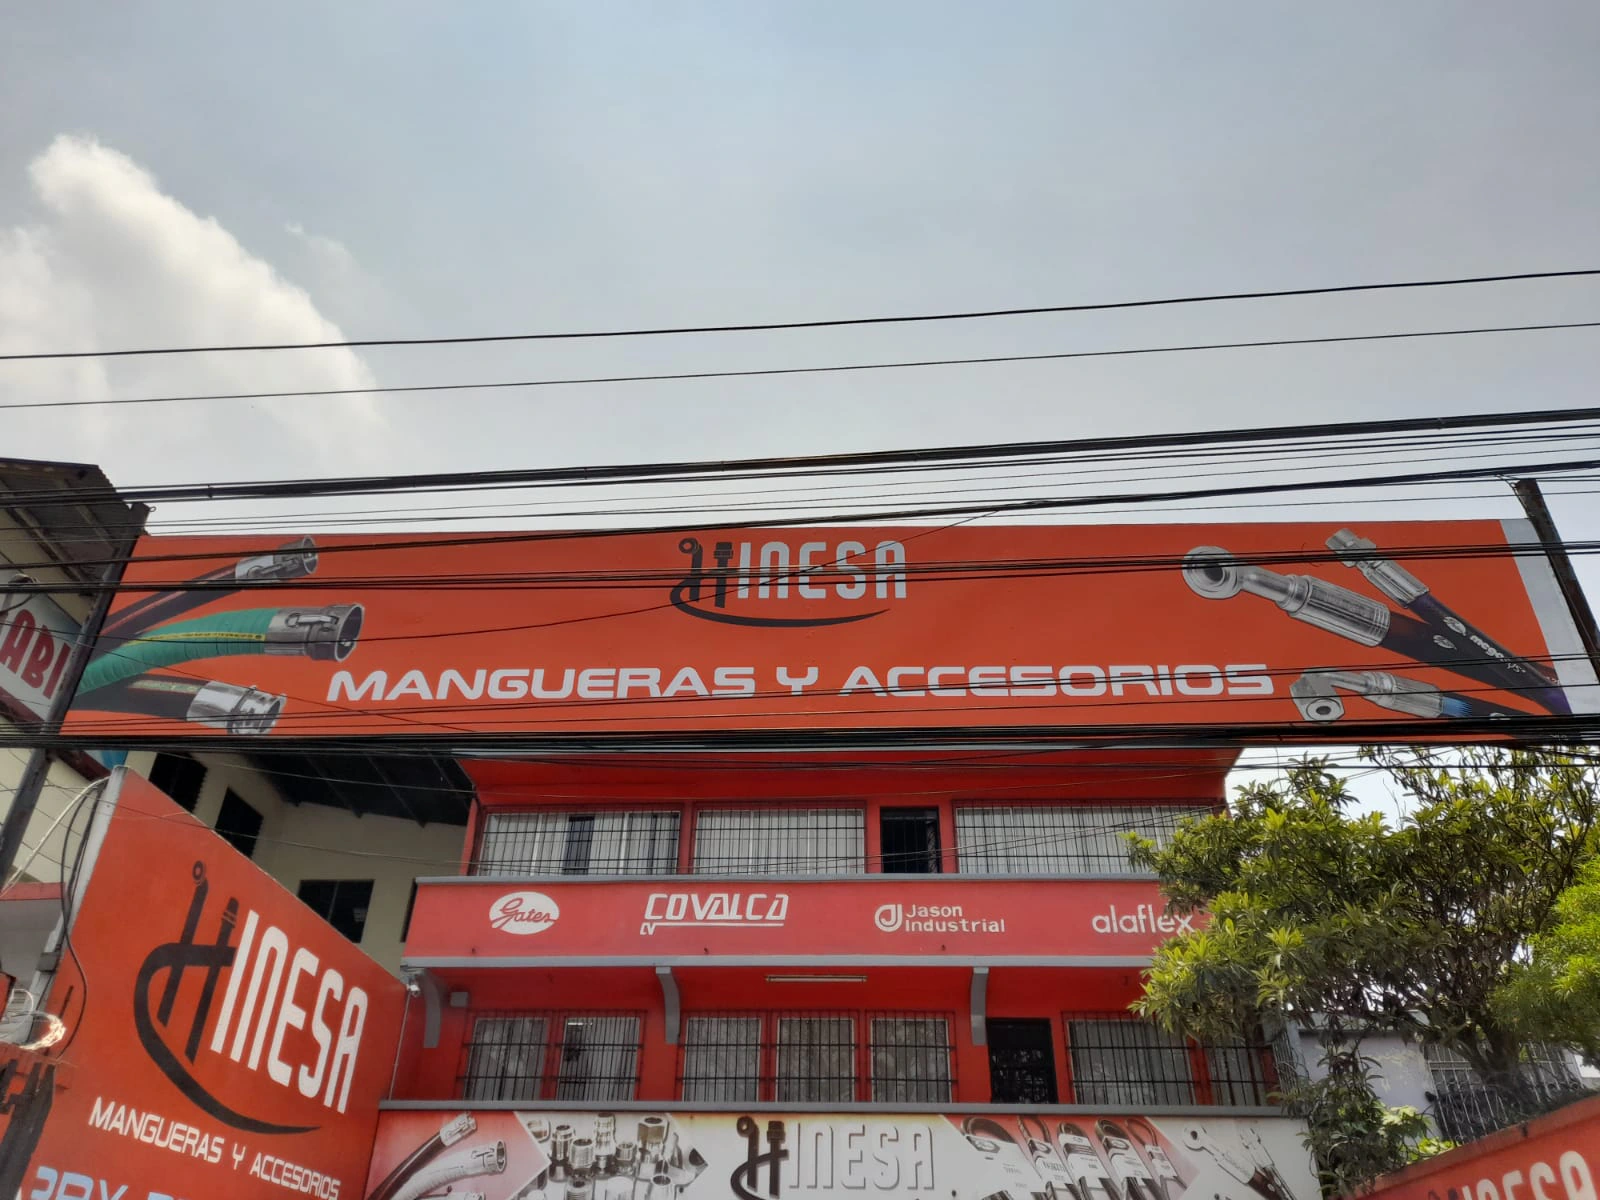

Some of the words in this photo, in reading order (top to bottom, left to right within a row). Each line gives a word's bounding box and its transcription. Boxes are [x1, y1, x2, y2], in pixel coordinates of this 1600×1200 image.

[326, 667, 755, 701] MANGUERAS
[776, 667, 818, 696] Y
[839, 664, 1274, 697] ACCESORIOS
[490, 897, 556, 929] Gates
[644, 893, 789, 921] COVALCA
[906, 904, 962, 918] Jason
[1092, 904, 1195, 937] alaflex
[905, 919, 1005, 932] Industrial
[88, 1096, 225, 1163] MANGUERAS
[232, 1143, 246, 1170] Y
[249, 1152, 341, 1200] ACCESORIOS
